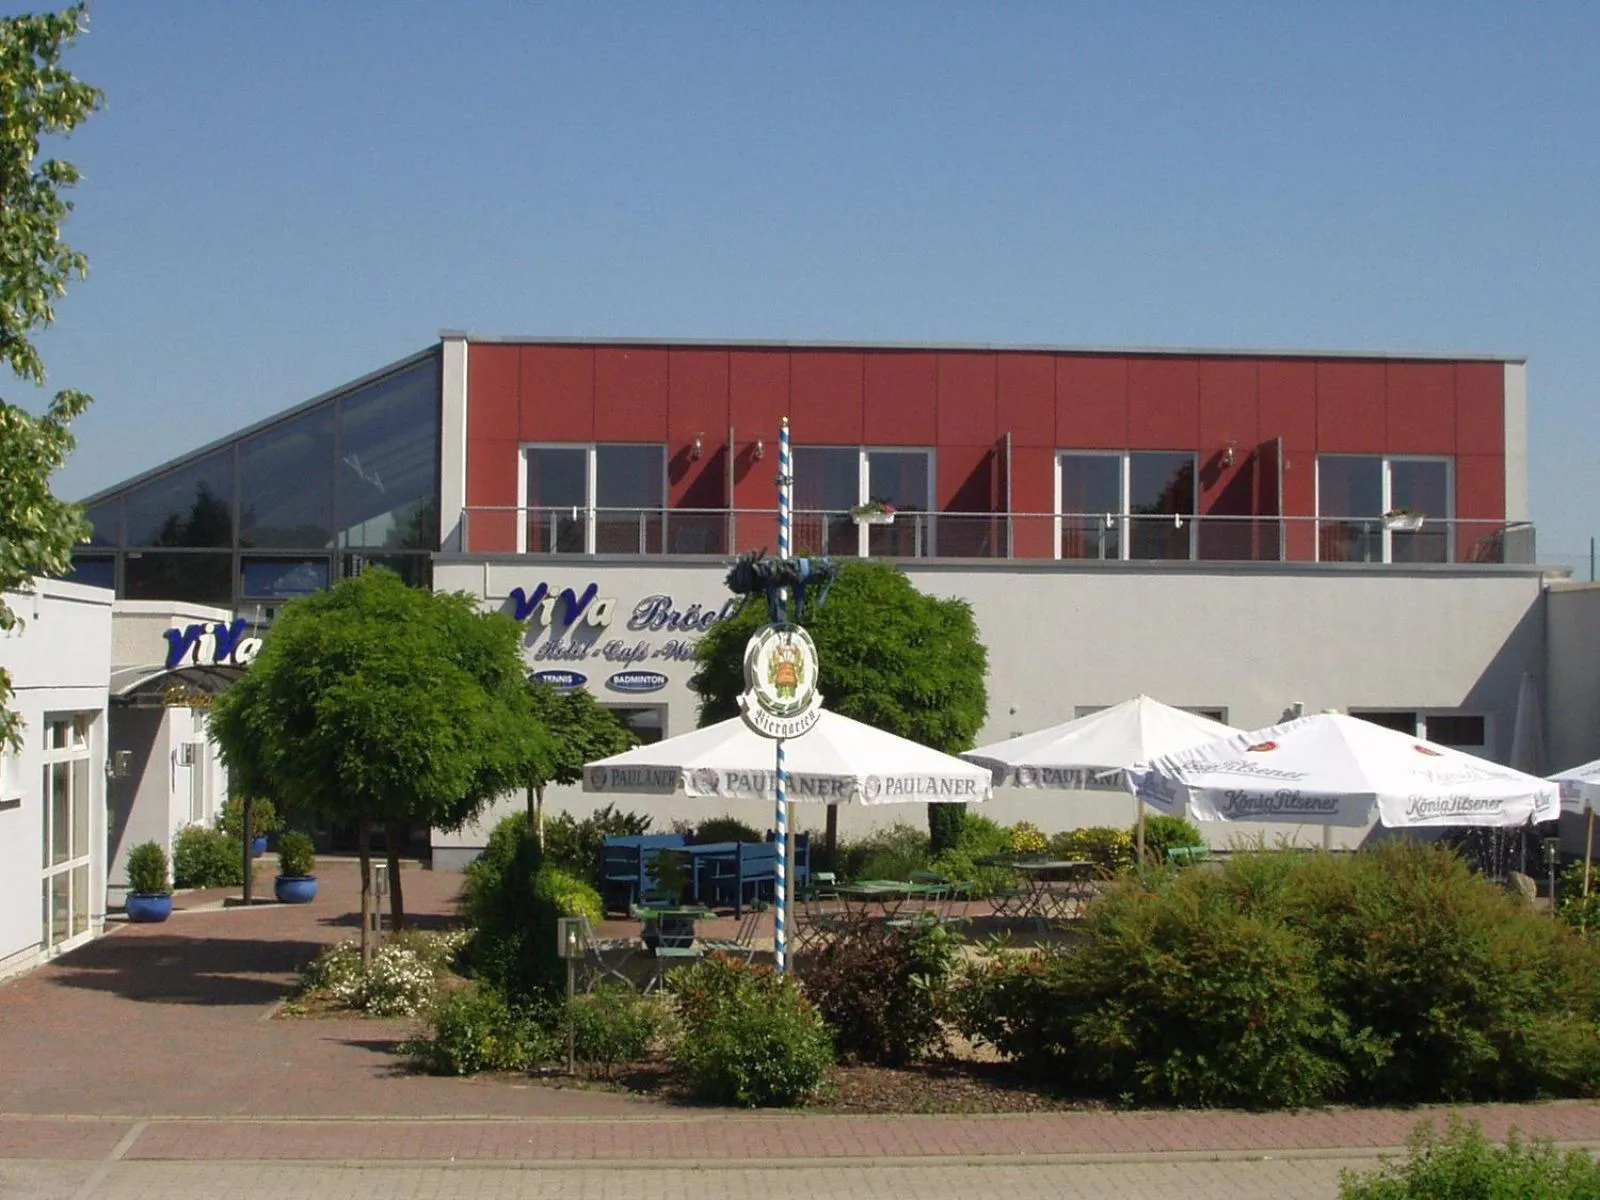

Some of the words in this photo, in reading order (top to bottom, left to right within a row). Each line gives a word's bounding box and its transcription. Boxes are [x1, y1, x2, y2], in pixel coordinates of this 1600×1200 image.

[542, 675, 573, 684] TENNIS
[613, 676, 665, 684] BADMINTON
[755, 709, 816, 738] Biergarten
[611, 769, 676, 787] PAULANER
[886, 776, 976, 795] PAULANER
